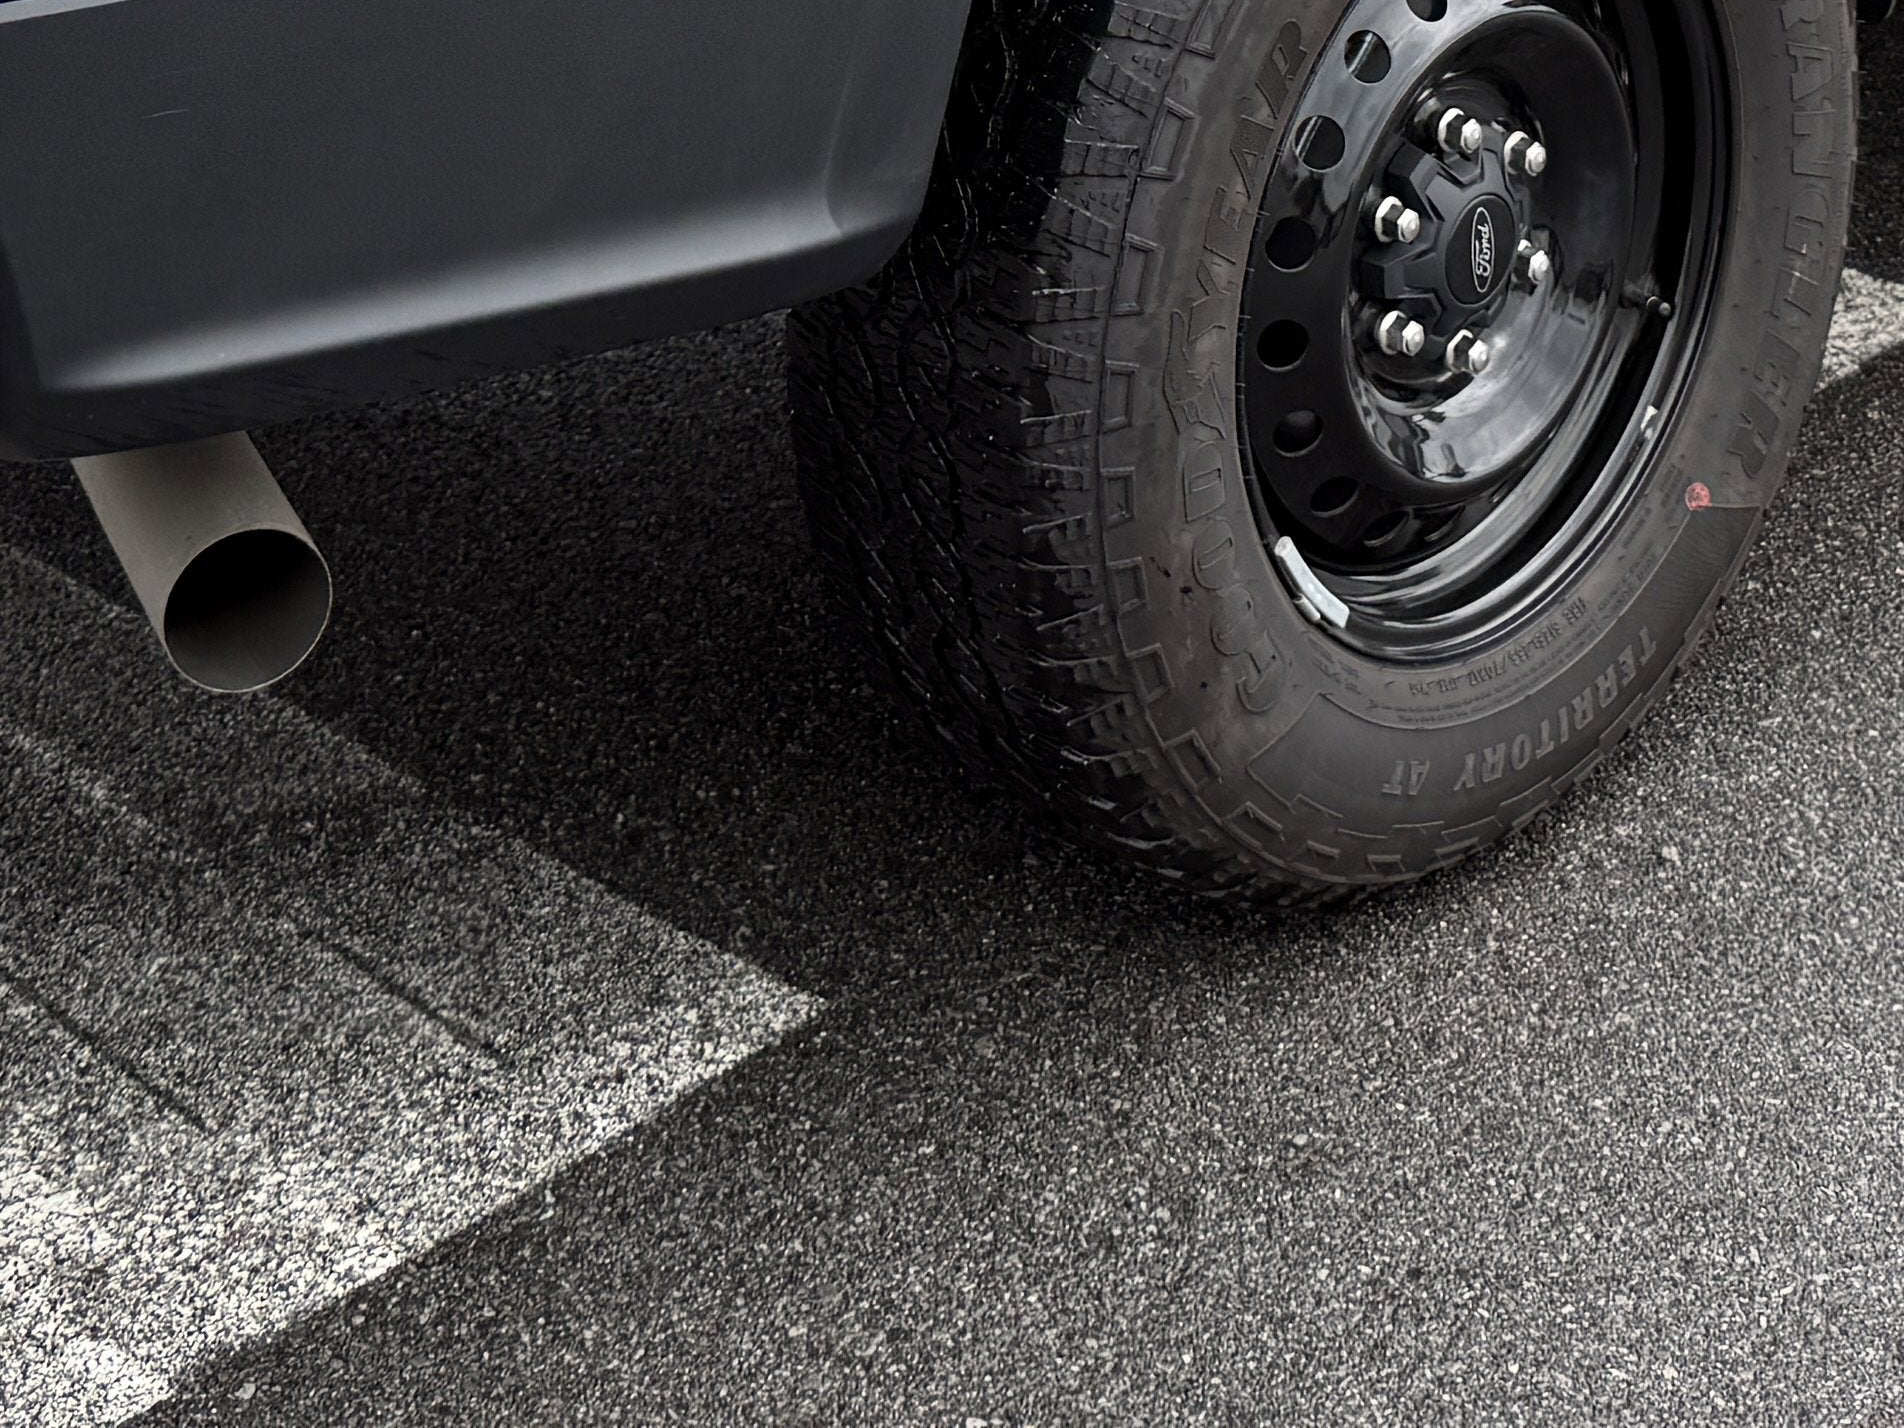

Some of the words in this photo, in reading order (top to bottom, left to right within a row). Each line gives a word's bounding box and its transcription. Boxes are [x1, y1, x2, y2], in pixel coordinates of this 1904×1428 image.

[1170, 20, 1309, 713] GOODYEAR
[1380, 759, 1431, 796] AT
[1452, 625, 1658, 792] TERRITORY
